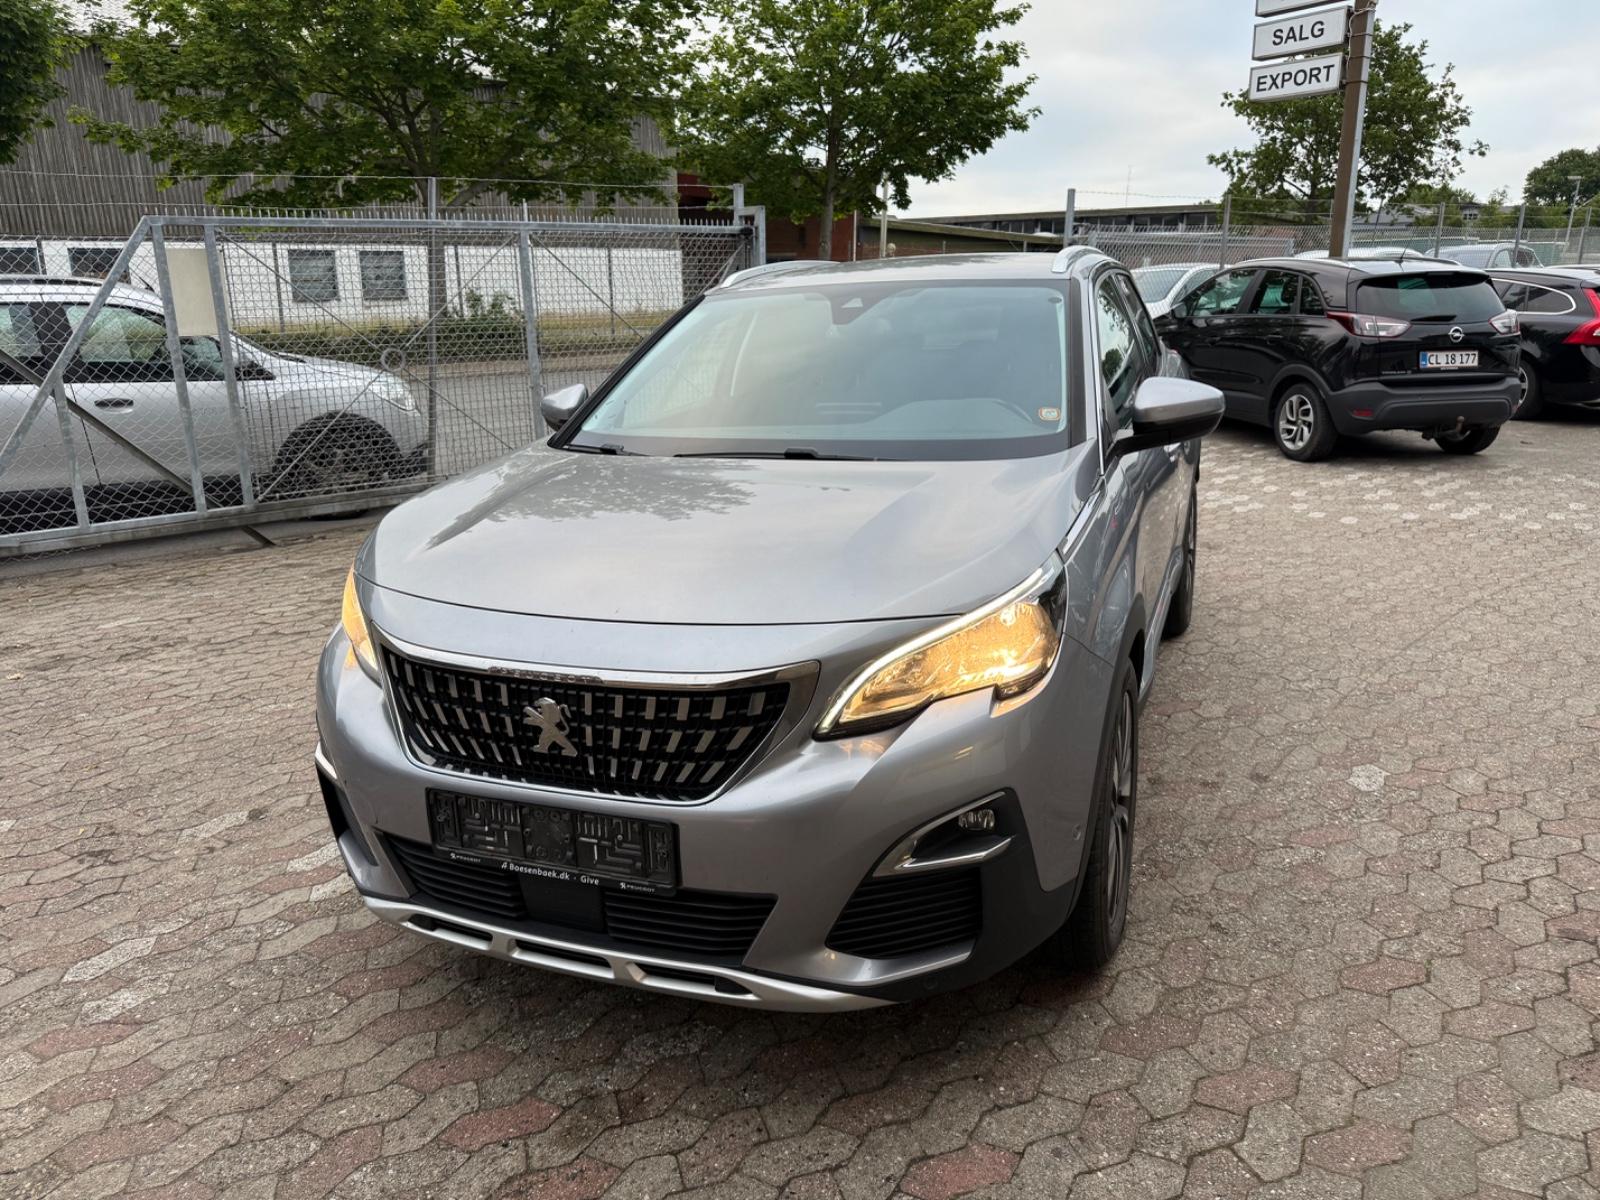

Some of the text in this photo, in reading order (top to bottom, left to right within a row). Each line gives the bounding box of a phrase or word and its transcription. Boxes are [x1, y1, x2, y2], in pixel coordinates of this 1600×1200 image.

[1272, 20, 1324, 46] SALG
[1256, 64, 1335, 92] EXPORT
[1428, 353, 1477, 365] CL 18 177
[580, 875, 600, 886] Give
